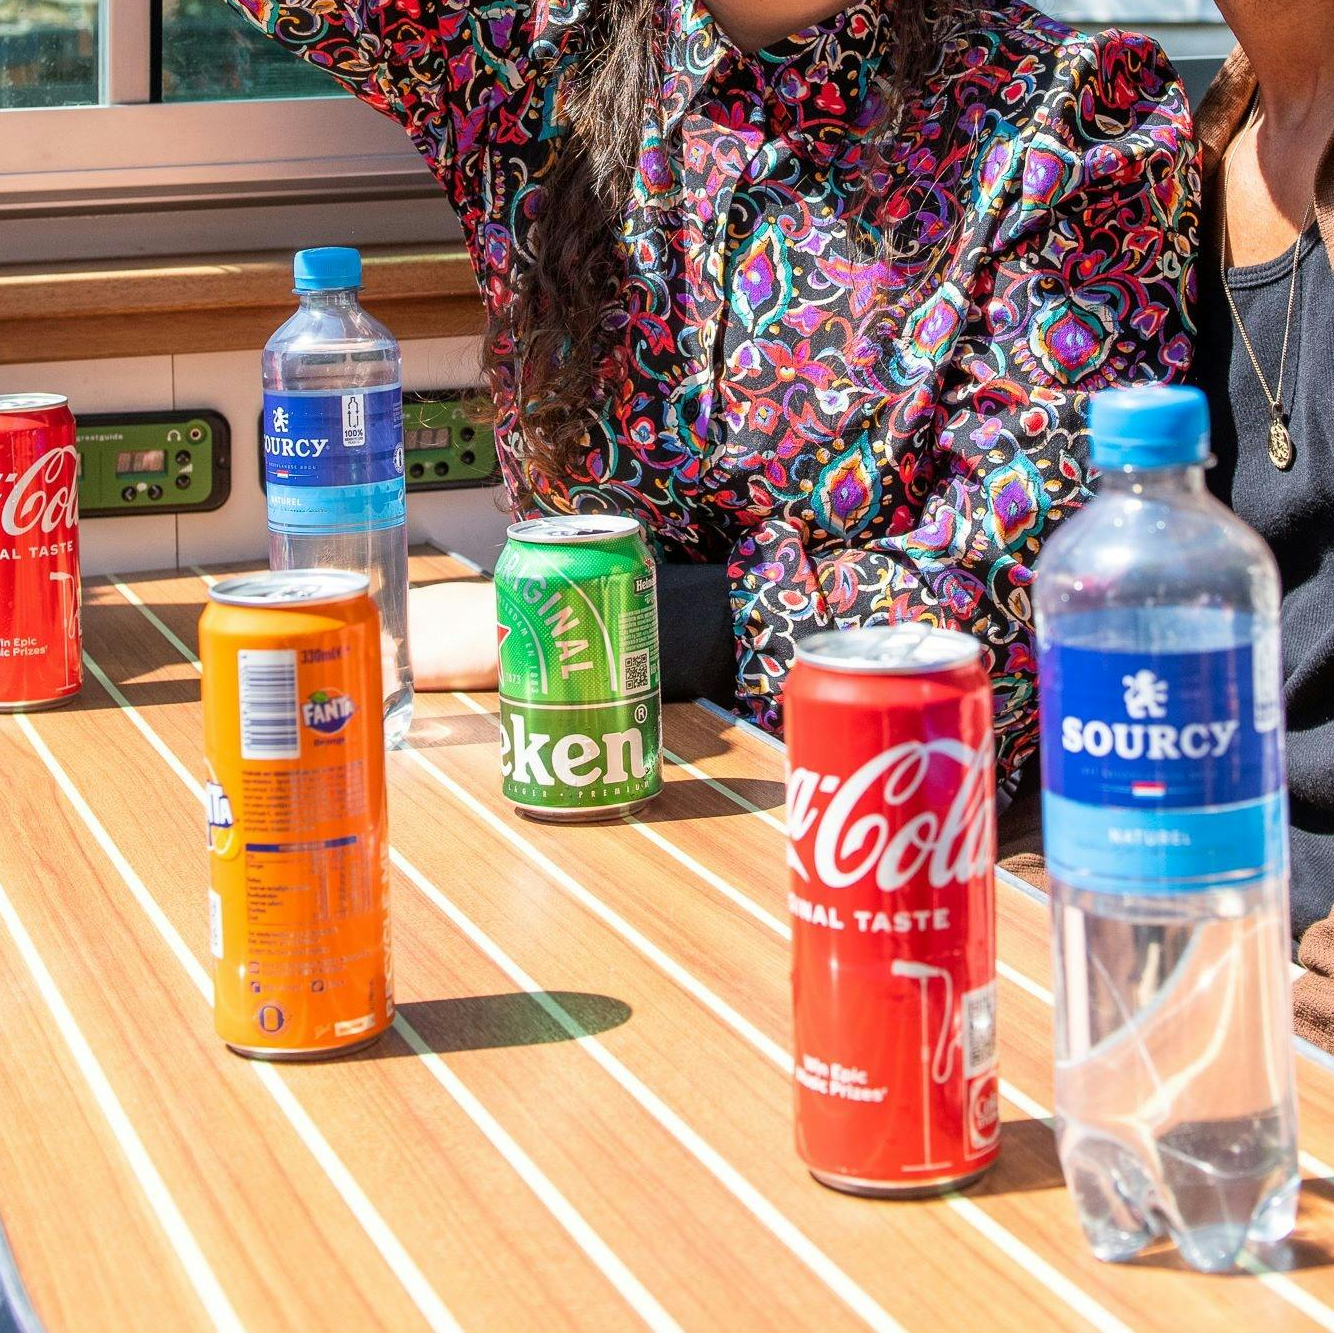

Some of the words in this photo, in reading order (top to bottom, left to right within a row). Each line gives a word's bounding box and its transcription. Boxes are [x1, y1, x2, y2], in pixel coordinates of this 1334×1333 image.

[264, 434, 329, 457] OURCY
[29, 541, 73, 559] TASTE
[13, 637, 37, 647] Epic
[301, 694, 355, 727] FANTA
[1062, 715, 1240, 760] SOURCY
[853, 908, 951, 933] TASTE
